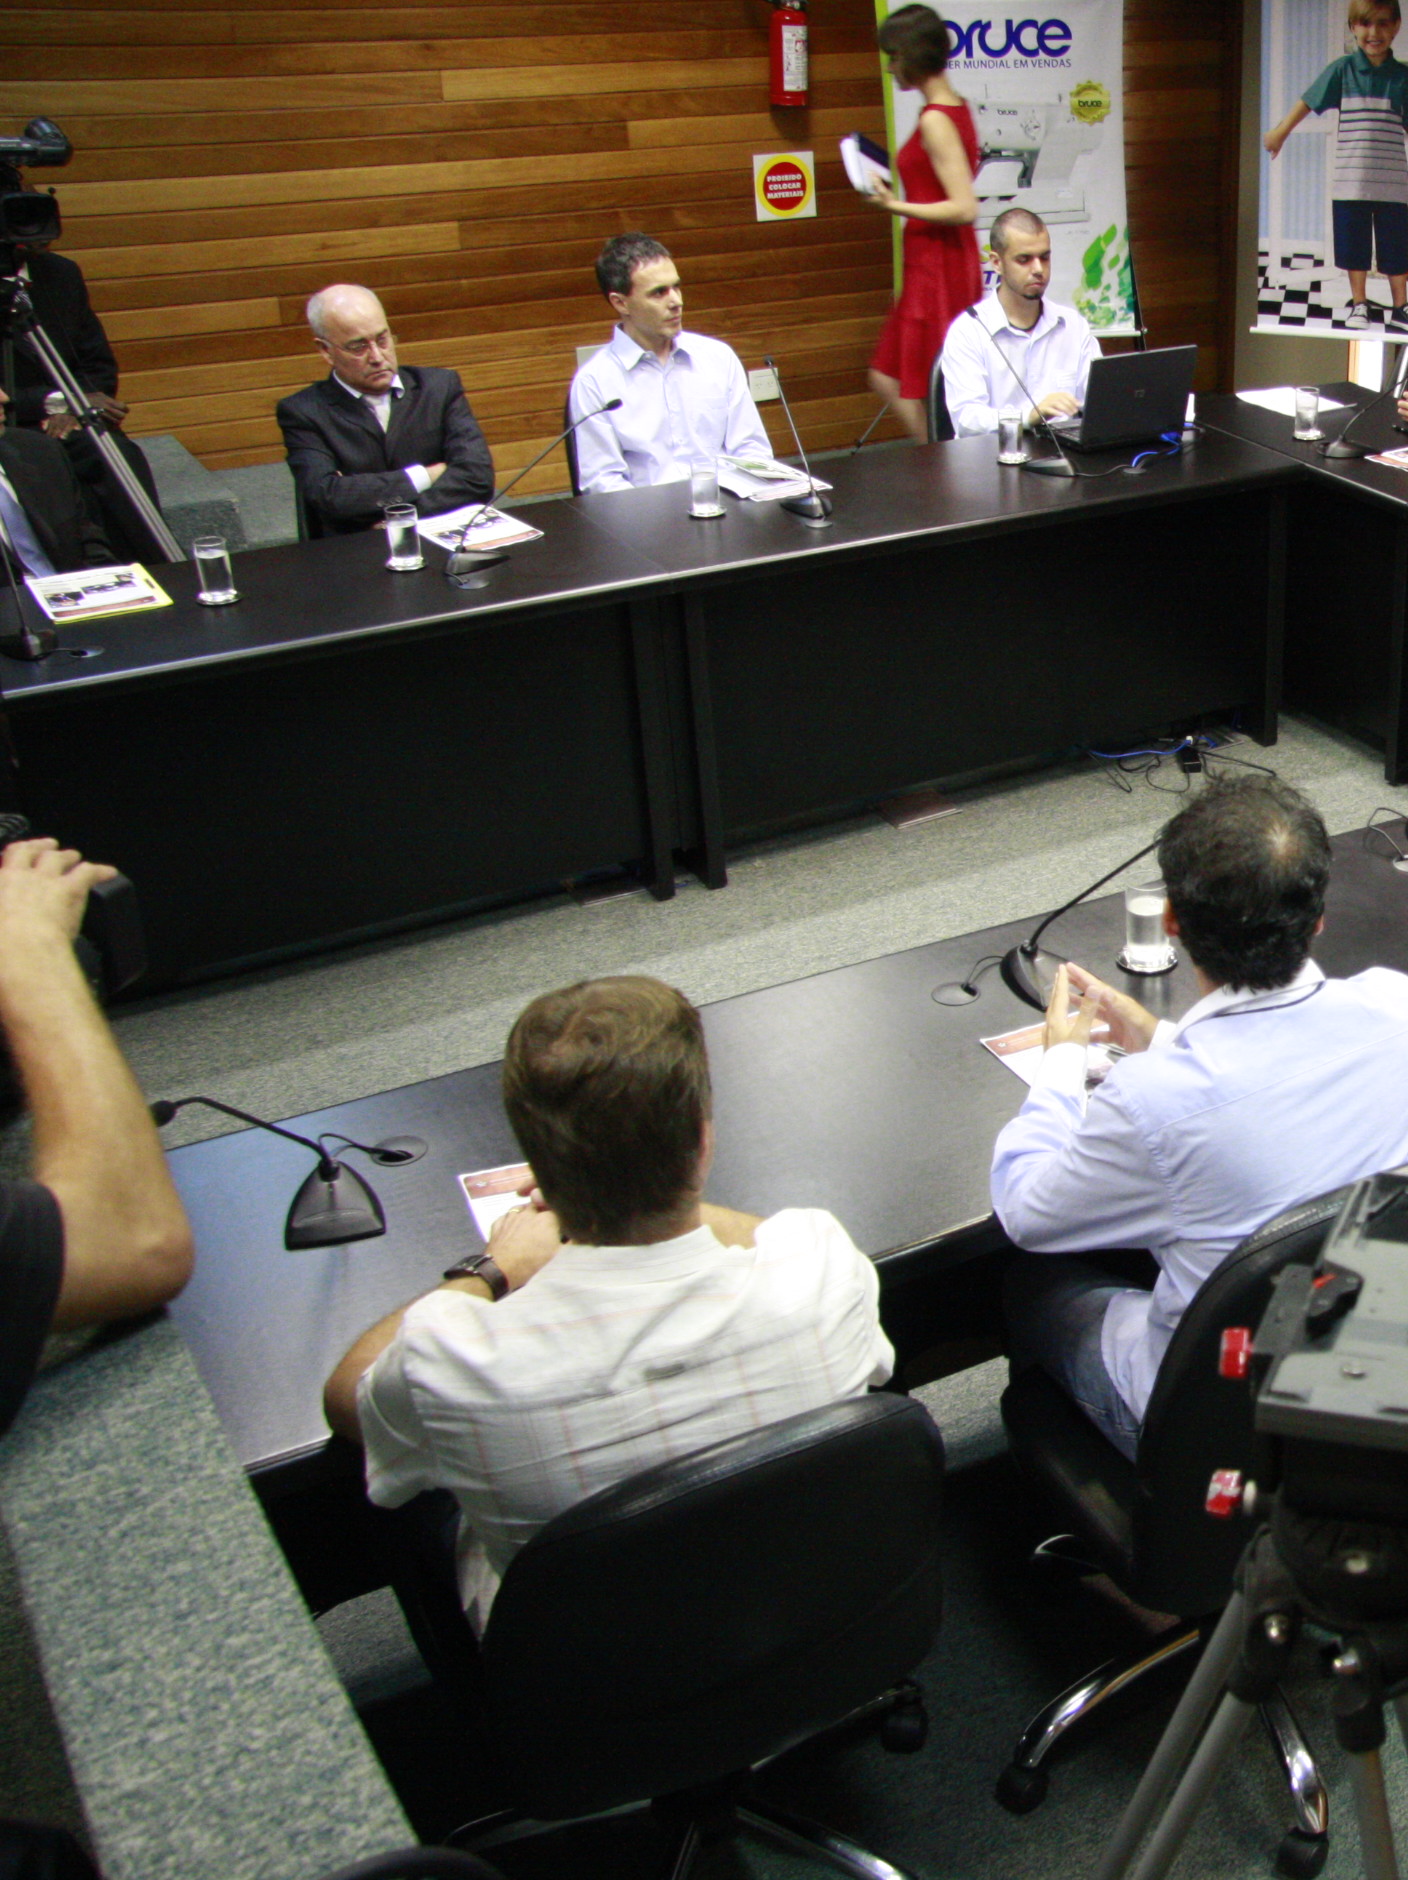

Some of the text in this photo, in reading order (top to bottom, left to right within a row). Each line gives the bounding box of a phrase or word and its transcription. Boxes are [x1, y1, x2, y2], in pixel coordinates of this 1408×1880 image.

[963, 60, 1011, 69] MUNDIAL
[1013, 60, 1029, 69] EM
[1031, 58, 1072, 68] VENDAS
[1077, 100, 1102, 108] bruce
[767, 174, 802, 182] PROIBIDO
[769, 182, 801, 190] COLOCAR
[767, 190, 803, 199] MATERIAIS
